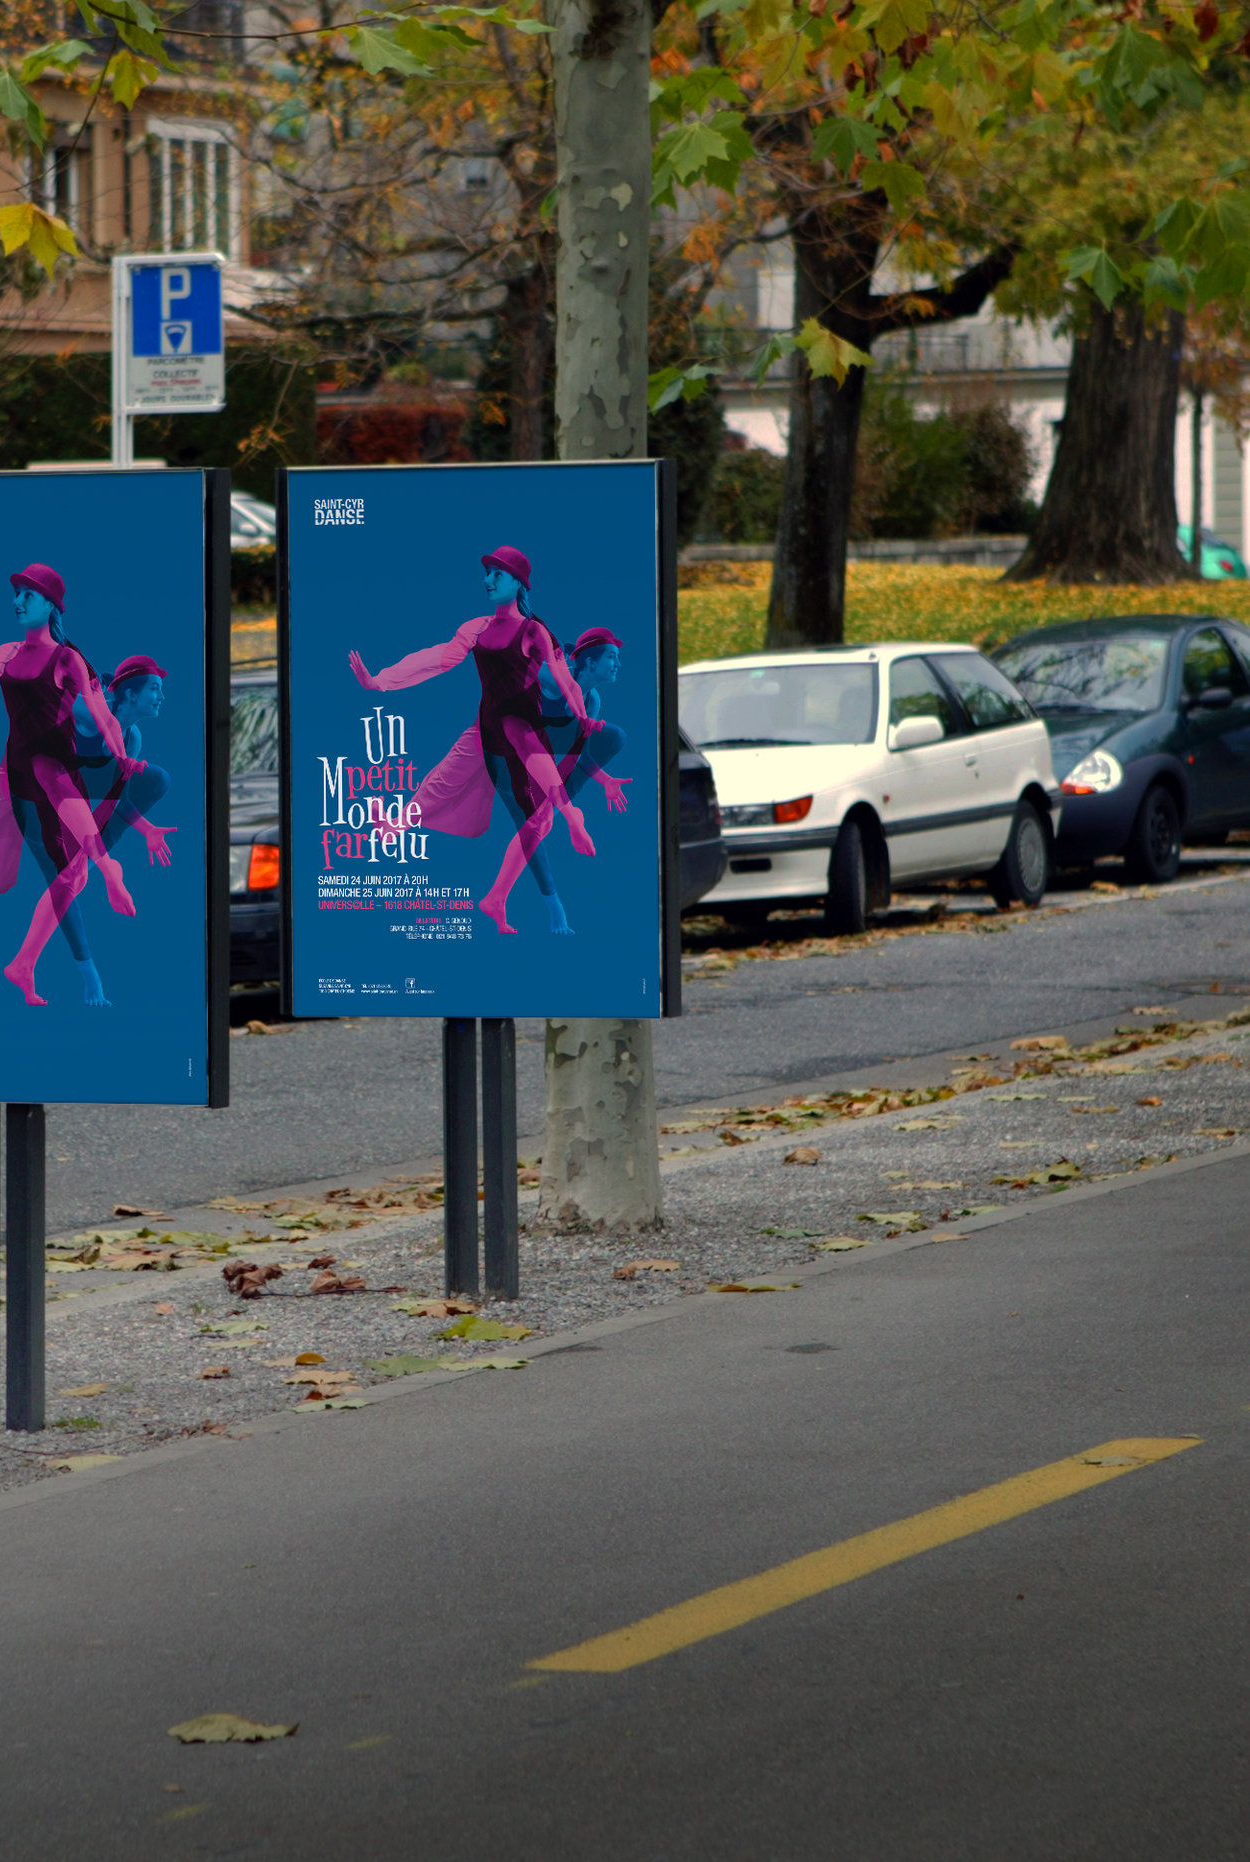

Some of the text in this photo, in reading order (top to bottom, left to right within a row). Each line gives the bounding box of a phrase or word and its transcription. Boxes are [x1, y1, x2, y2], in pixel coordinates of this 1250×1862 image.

[161, 267, 191, 320] P
[314, 498, 364, 509] SAINT-CYR
[360, 705, 409, 765] Un
[316, 756, 422, 830] Monde
[343, 758, 420, 800] petit
[320, 826, 430, 870] farfelu
[317, 876, 349, 885] SAMEDI
[350, 876, 361, 885] 24
[362, 876, 381, 885] JUIN
[382, 876, 402, 885] 2017
[403, 873, 410, 885] À
[318, 888, 361, 897] DIMANCHE
[362, 888, 373, 897] 25
[374, 888, 393, 897] JUIN
[394, 888, 414, 898] 2017
[415, 886, 422, 898] À
[441, 888, 451, 898] ET
[384, 900, 403, 910] 1618
[403, 898, 474, 910] CHÂTEL-ST-DENIS
